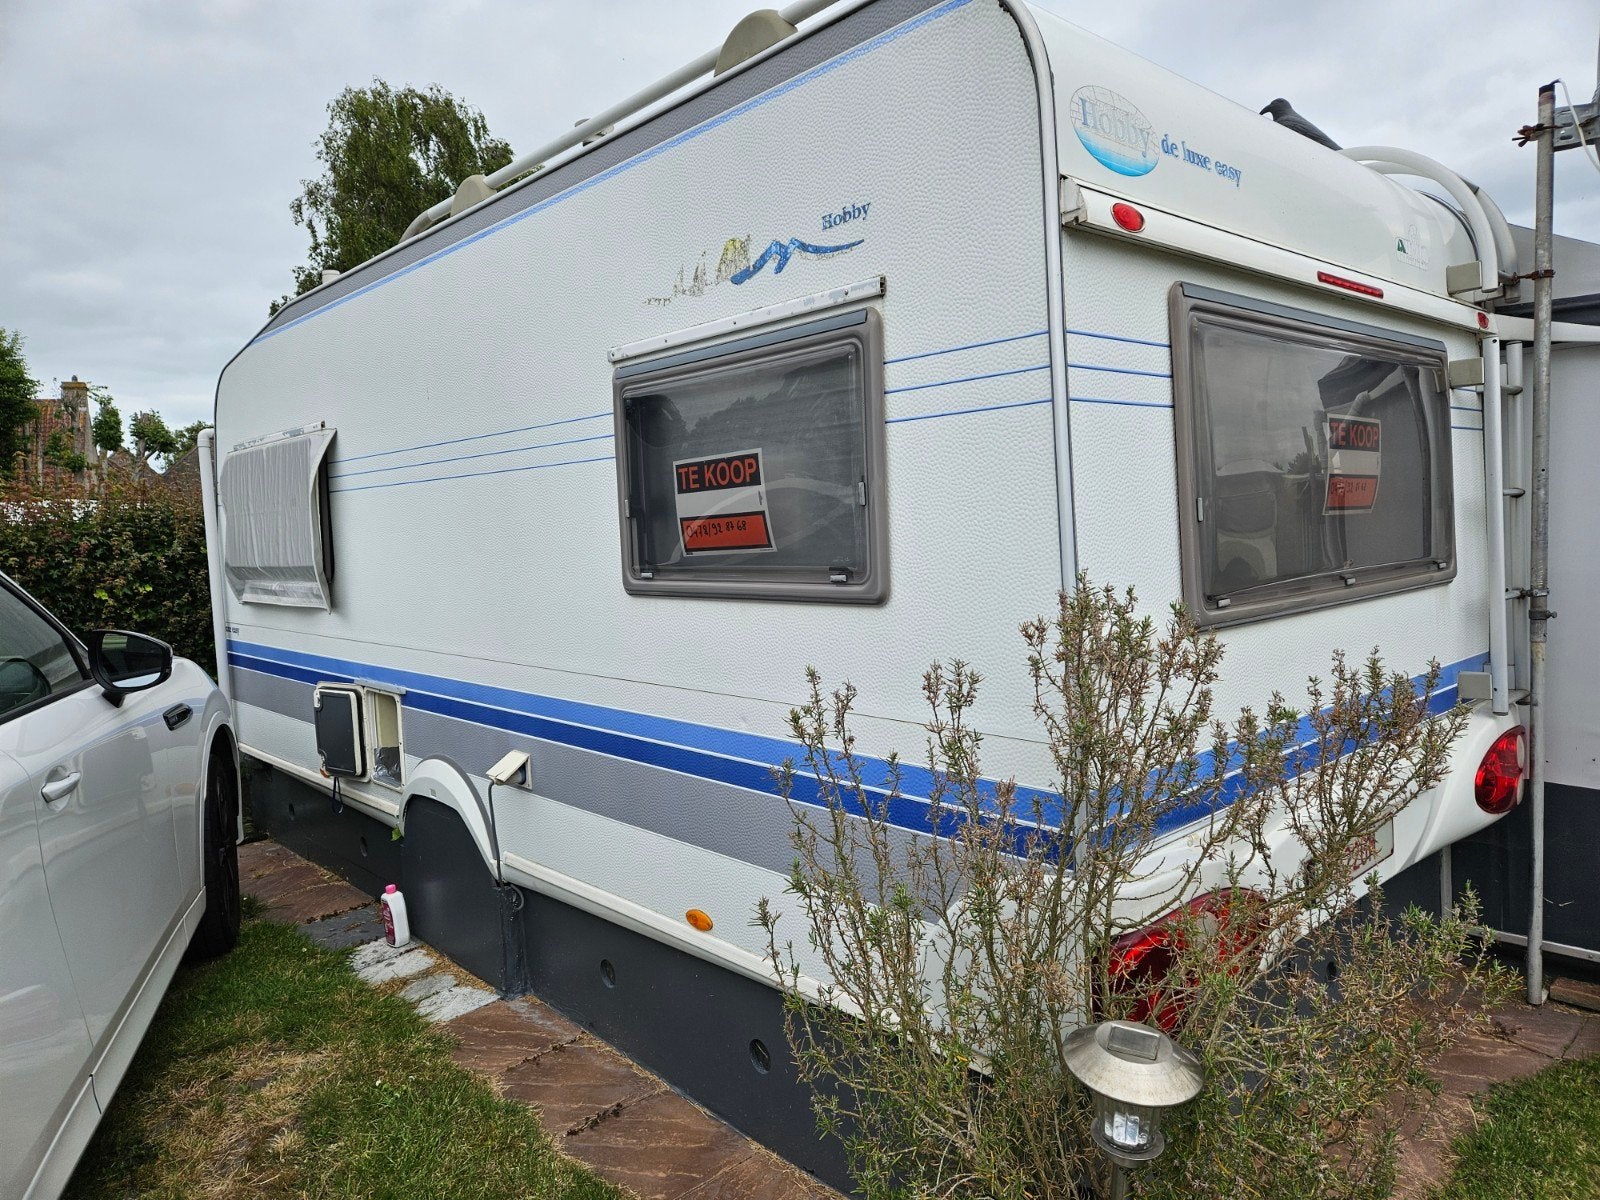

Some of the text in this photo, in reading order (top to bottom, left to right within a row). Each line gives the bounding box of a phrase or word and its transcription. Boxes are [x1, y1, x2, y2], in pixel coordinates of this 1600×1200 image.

[1079, 97, 1150, 159] Hobby
[1161, 133, 1242, 188] de luxe easy
[821, 202, 871, 230] Hobby
[1331, 421, 1379, 448] TE KOOP
[678, 458, 757, 490] TE KOOP
